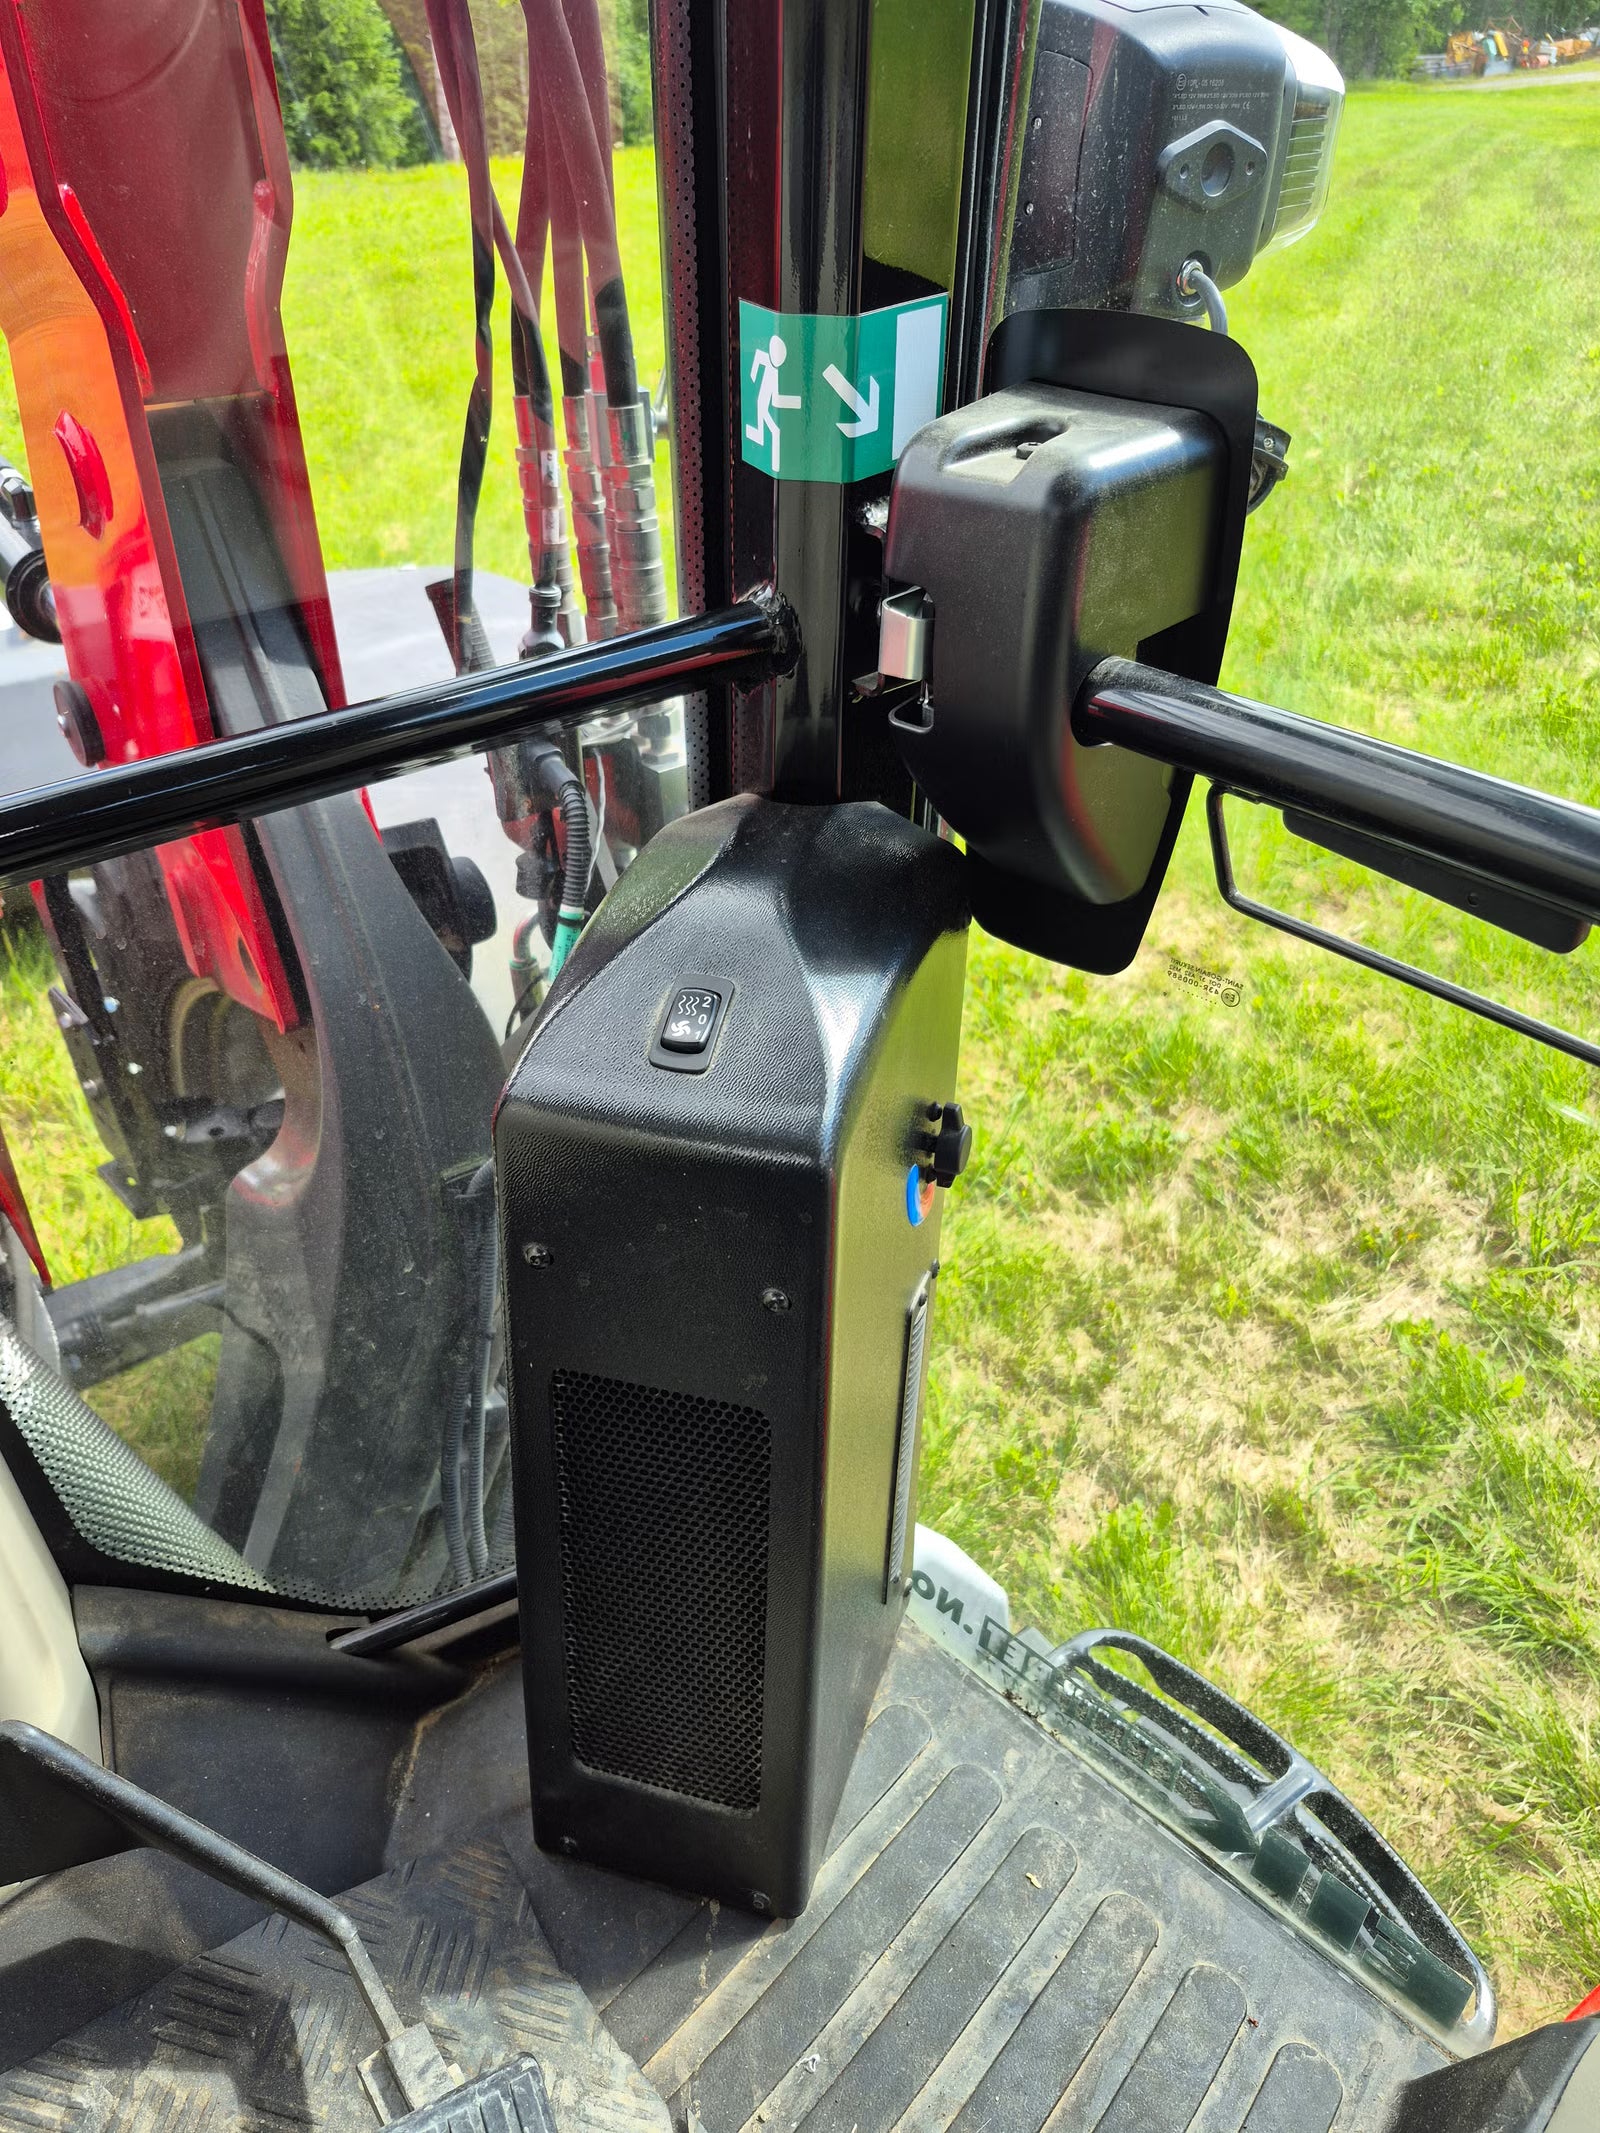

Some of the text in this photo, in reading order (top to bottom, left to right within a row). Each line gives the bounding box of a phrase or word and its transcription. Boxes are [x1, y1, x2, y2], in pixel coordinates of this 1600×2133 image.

[702, 996, 711, 1007] 2
[698, 1014, 707, 1025] 0
[695, 1031, 701, 1040] 1
